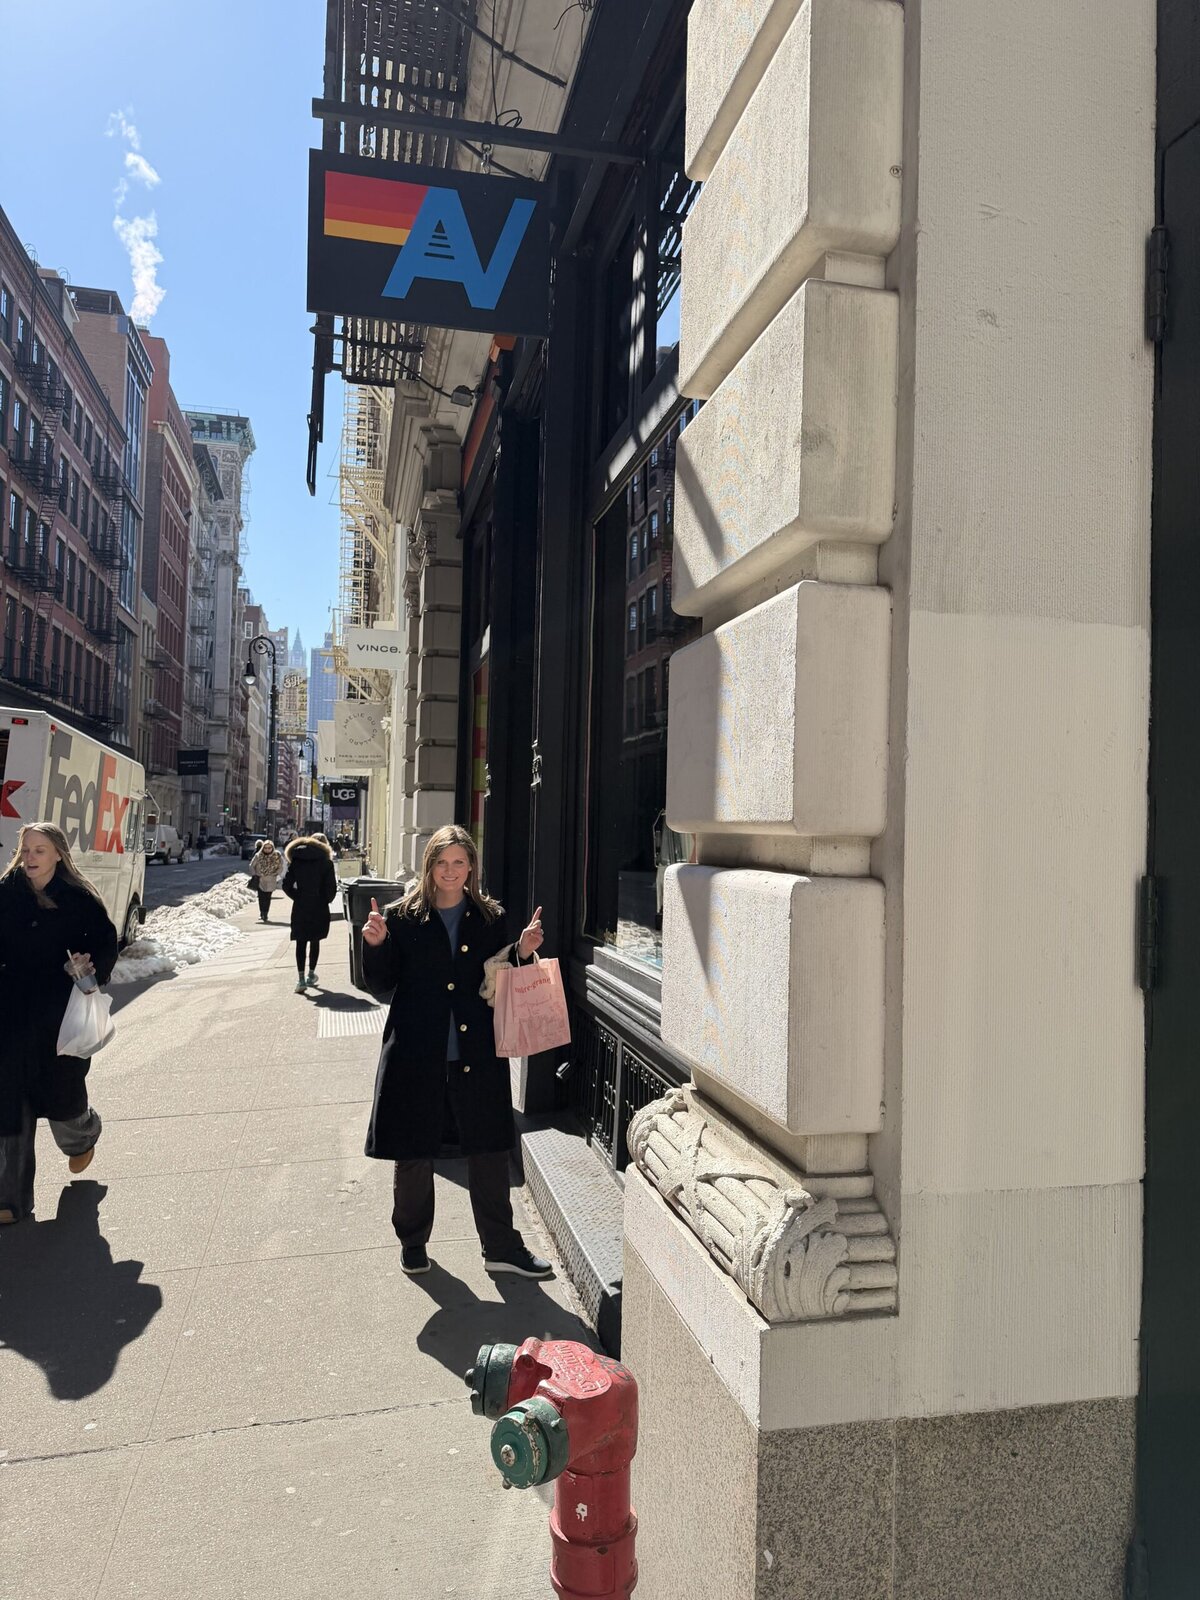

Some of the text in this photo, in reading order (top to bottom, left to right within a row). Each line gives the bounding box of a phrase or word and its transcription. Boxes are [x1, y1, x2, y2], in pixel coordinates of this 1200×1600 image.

[381, 186, 537, 311] AV
[44, 729, 130, 854] FedEx
[332, 788, 356, 801] UGG
